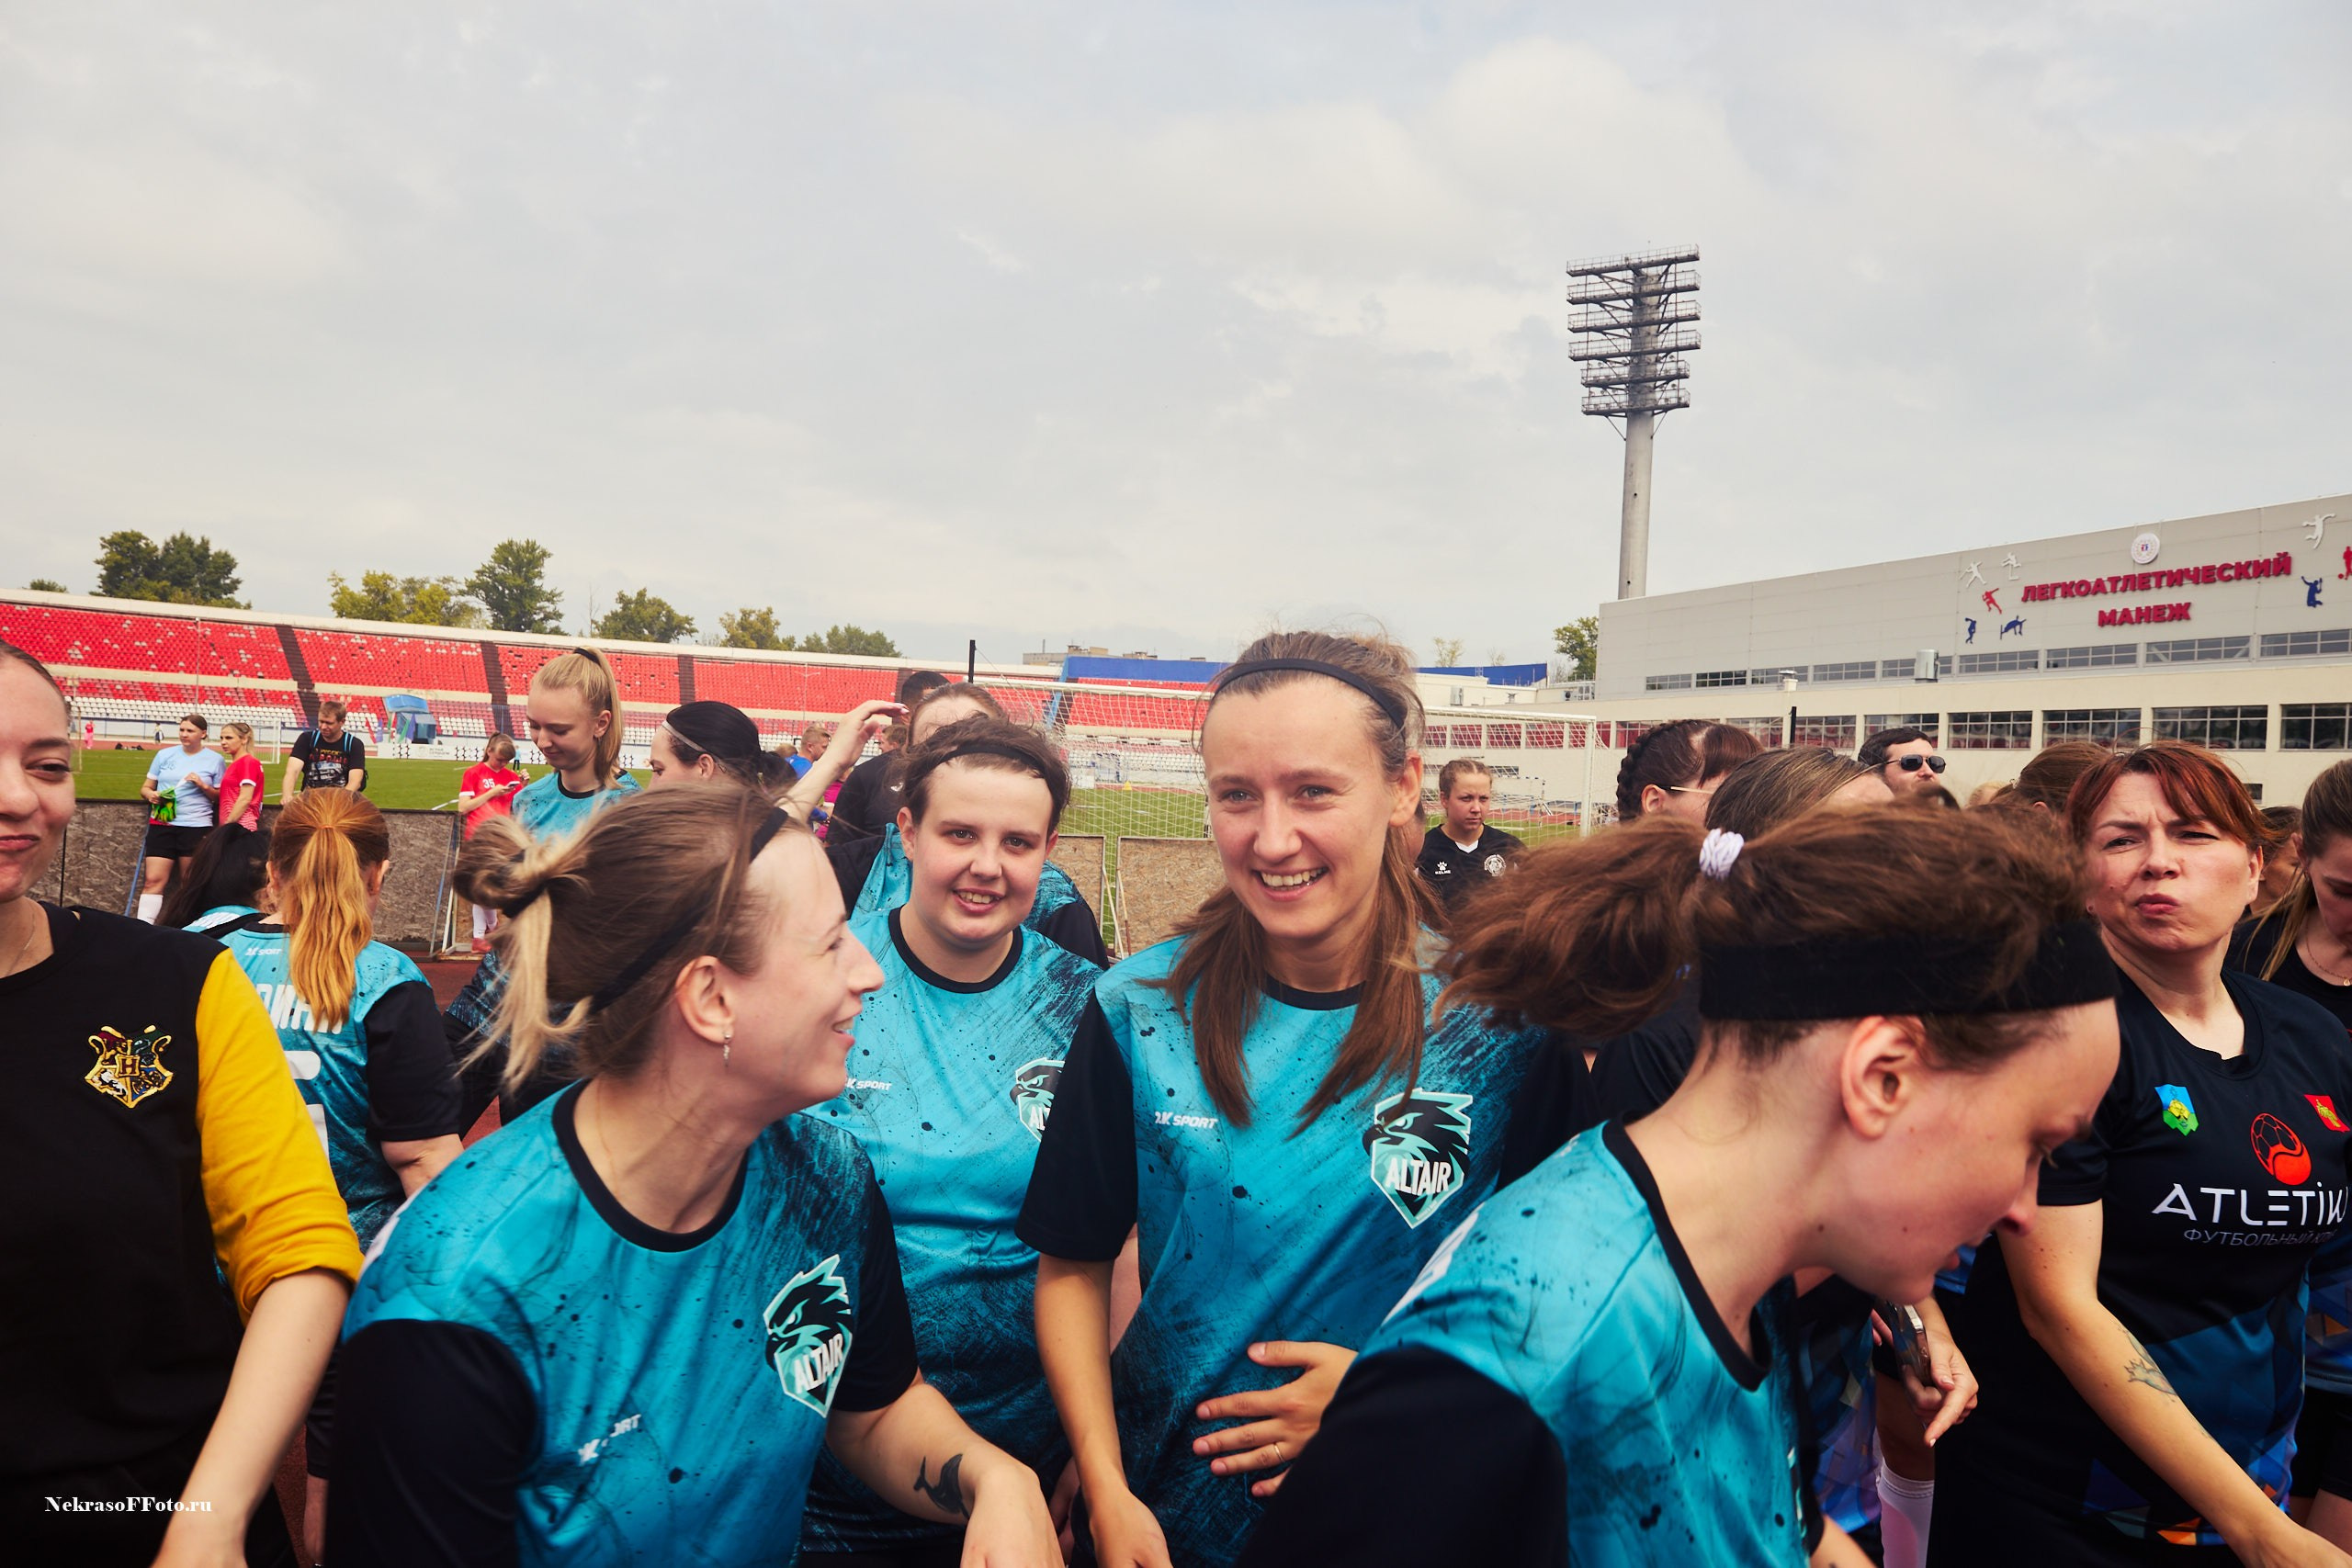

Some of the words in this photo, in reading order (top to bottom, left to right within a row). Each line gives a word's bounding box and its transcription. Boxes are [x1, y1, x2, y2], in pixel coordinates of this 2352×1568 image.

[2021, 551, 2292, 603] ЛЕГКОАТЛЕТИЧЕСКИЙ
[2098, 602, 2192, 627] МАНЕЖ
[482, 778, 496, 789] 35
[855, 1079, 893, 1091] SPORT
[1171, 1114, 1219, 1129] SPORT
[1385, 1157, 1452, 1196] ALTAIR
[794, 1333, 843, 1394] ALTAIR
